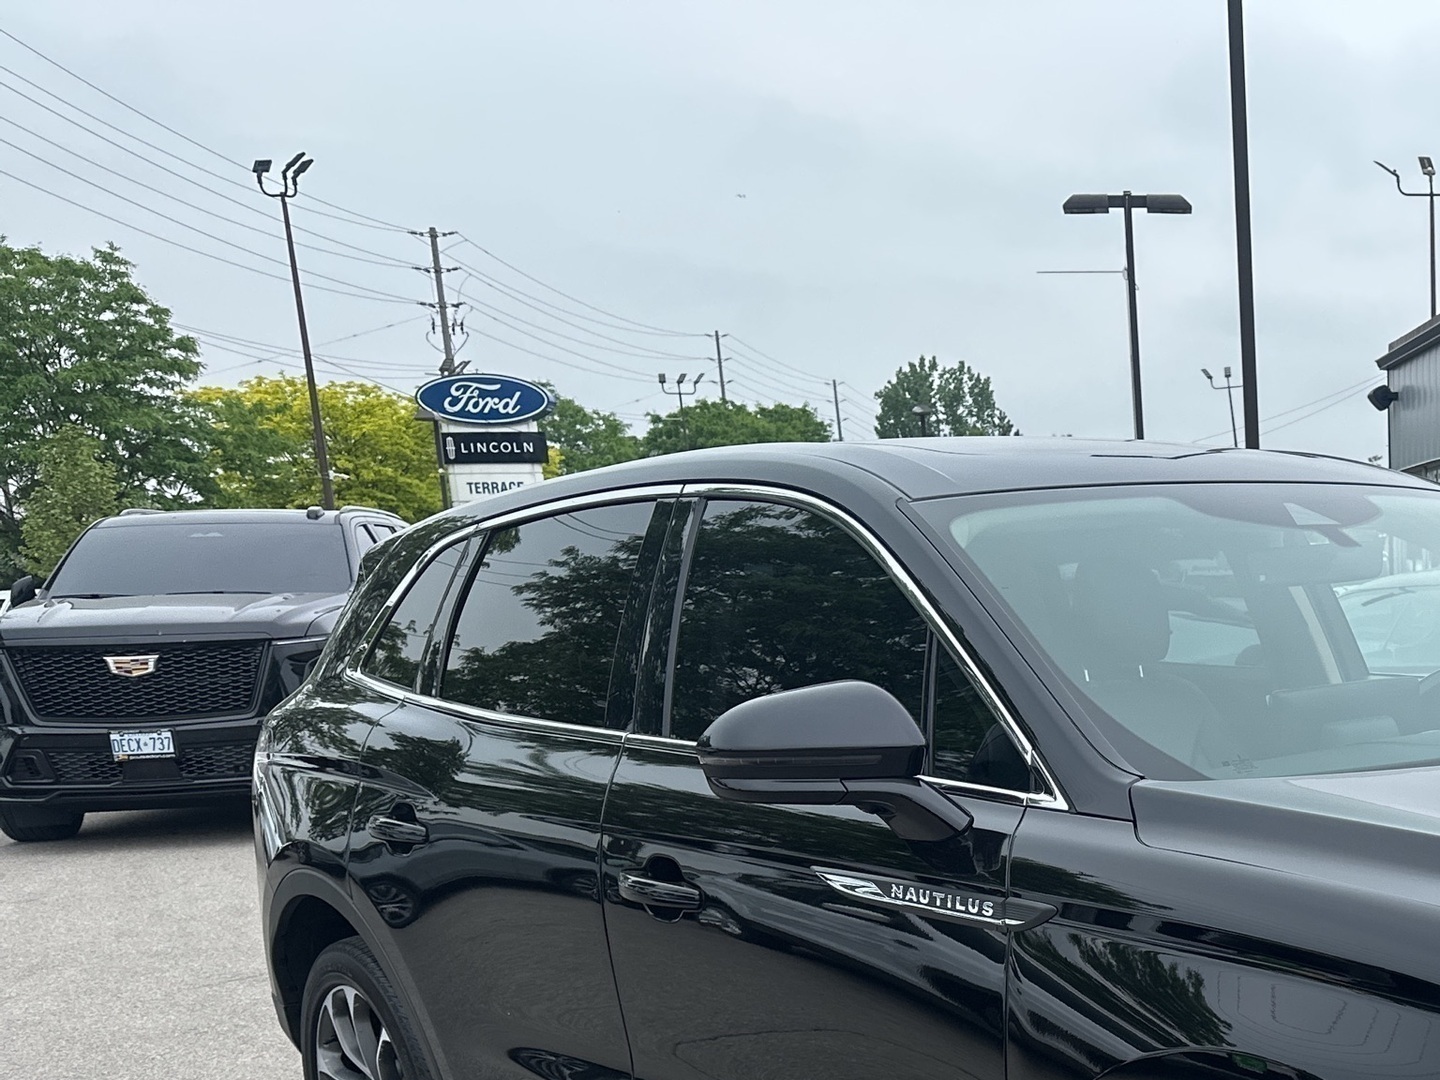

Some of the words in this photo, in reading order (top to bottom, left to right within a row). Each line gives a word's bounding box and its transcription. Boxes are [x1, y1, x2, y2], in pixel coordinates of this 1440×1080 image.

[443, 381, 521, 414] Ford
[460, 442, 534, 454] LINCOLN
[112, 738, 143, 753] DECX
[149, 737, 171, 751] 737
[890, 883, 994, 917] NAUTILUS
